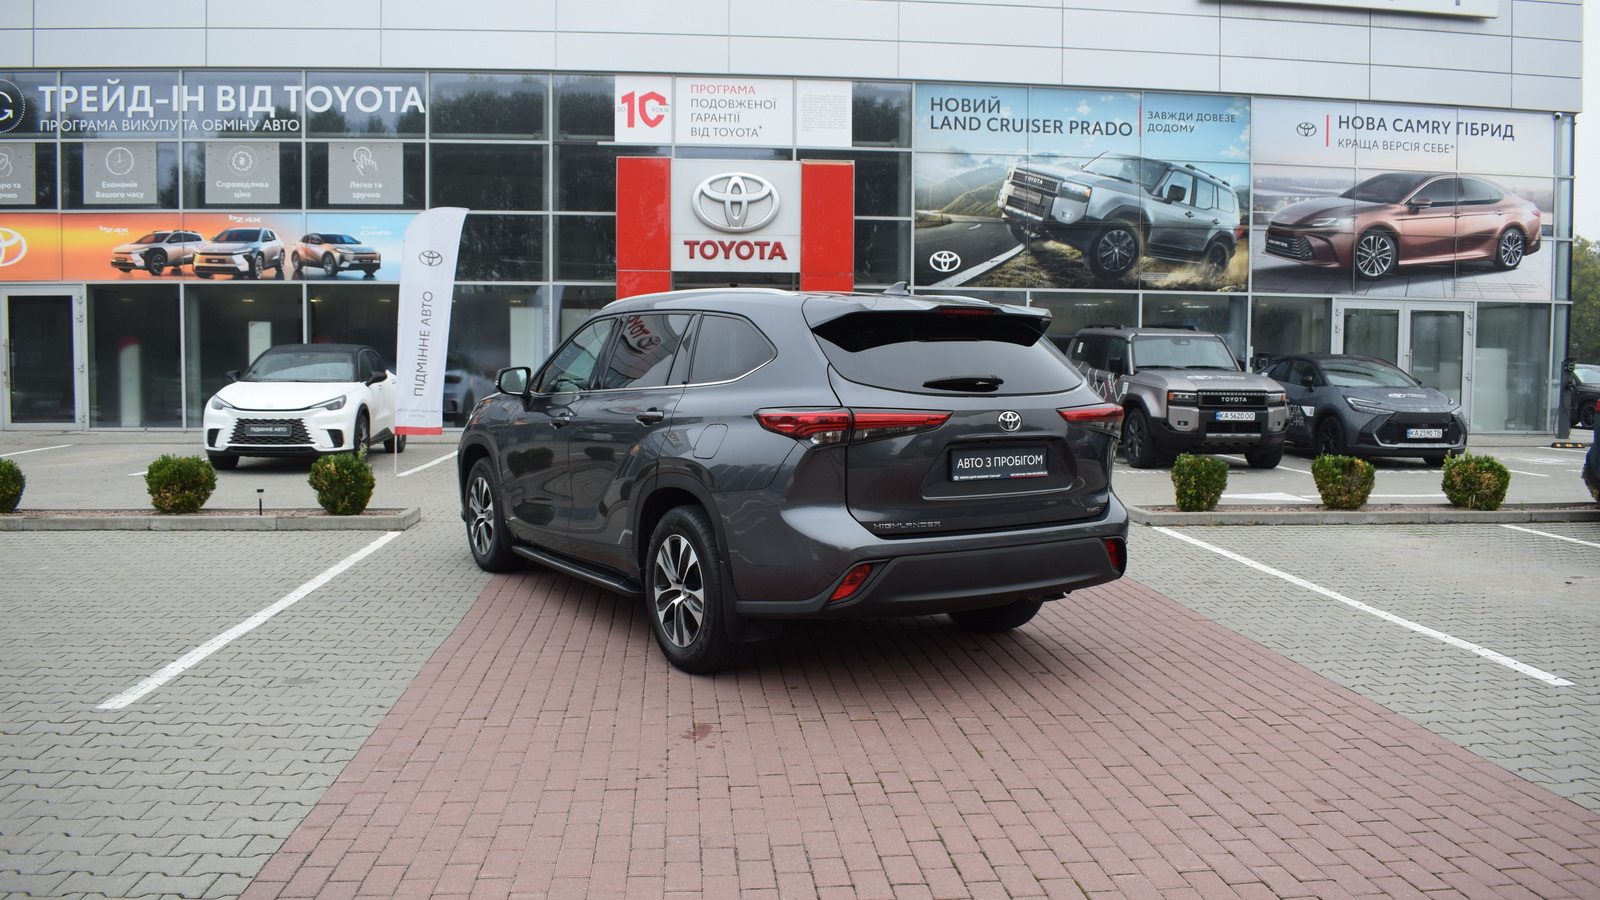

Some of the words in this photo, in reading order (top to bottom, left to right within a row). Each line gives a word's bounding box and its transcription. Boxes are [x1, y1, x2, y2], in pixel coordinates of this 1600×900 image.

[690, 84, 756, 95] ПРОГРАМА
[38, 78, 204, 118] ТРЕЙД-ІН
[217, 85, 275, 118] ВІД
[284, 85, 426, 113] TOYOTA
[690, 98, 777, 110] ПОДОВЖЕНОЇ
[930, 95, 1001, 114] НОВИЙ
[690, 111, 741, 123] ГАРАНТІЇ
[1147, 110, 1194, 122] ЗАВЖДИ
[1195, 113, 1236, 123] ДОВЕЗЕ
[40, 119, 118, 132] ПРОГРАМА
[122, 119, 179, 132] ВИКУПУ
[182, 119, 198, 132] ТА
[202, 119, 260, 132] ОБМІНУ
[262, 119, 300, 132] АВТО
[930, 115, 981, 131] LAND
[986, 117, 1064, 135] CRUISER
[1069, 120, 1133, 137] PRADO
[1147, 123, 1196, 134] ДОДОМУ
[1338, 115, 1388, 132] НОВА
[1392, 118, 1452, 135] CAMRY
[1455, 121, 1515, 141] ГІБРИД
[690, 126, 710, 138] ВІД
[1338, 138, 1380, 152] КРАЩА
[1382, 140, 1421, 152] ВЕРСІЯ
[101, 181, 138, 189] Економія
[216, 181, 269, 190] Справедлива
[349, 181, 372, 189] Легко
[1024, 175, 1043, 185] TOYOTA
[95, 191, 125, 199] Вашого
[126, 192, 145, 200] часу
[234, 191, 251, 199] ціна
[683, 240, 788, 261] TOYOTA
[419, 291, 433, 327] АВТО
[413, 330, 430, 397] ПІДМІННЕ
[1230, 412, 1245, 420] 5620
[956, 457, 984, 469] АВТО
[993, 454, 1044, 467] ПРОБІГОМ
[873, 520, 941, 530] HIGHLANDER
